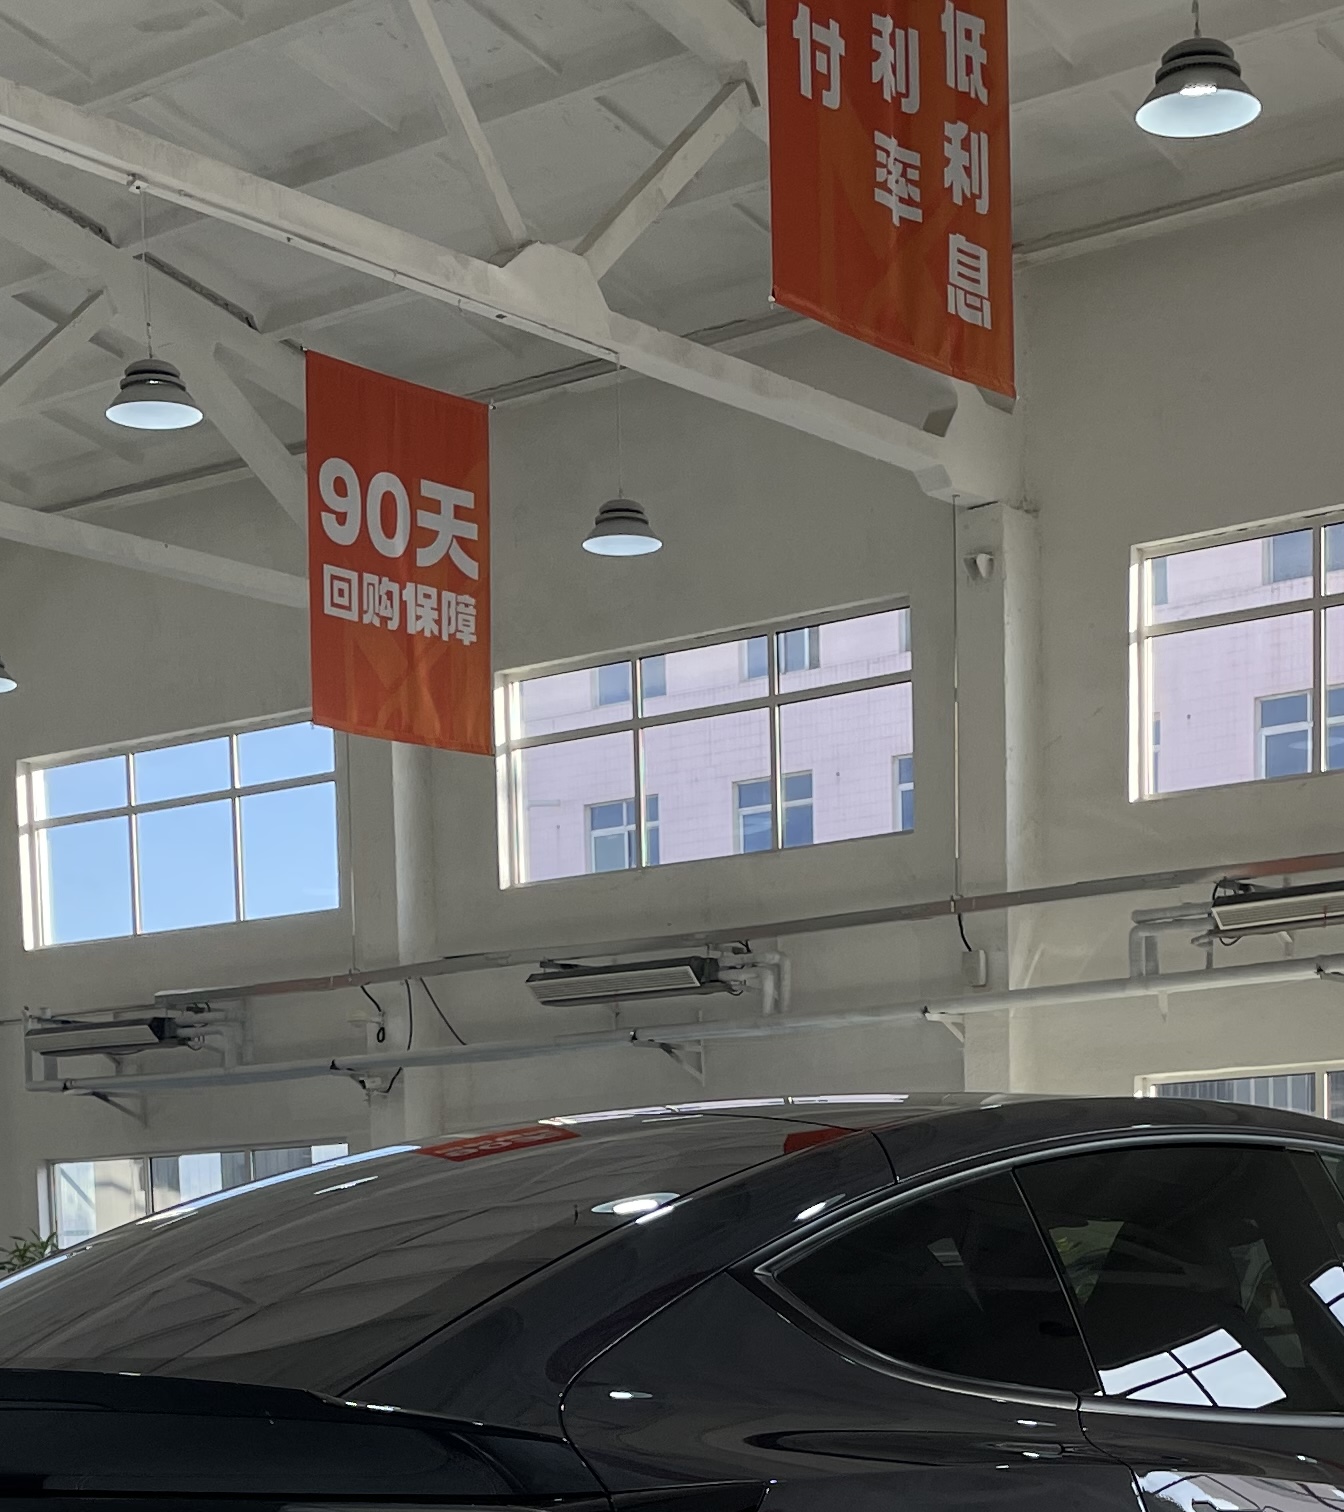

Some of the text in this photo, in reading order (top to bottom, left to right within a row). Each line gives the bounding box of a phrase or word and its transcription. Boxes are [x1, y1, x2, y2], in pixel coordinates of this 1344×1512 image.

[871, 12, 923, 227] 利率
[940, 0, 992, 330] 低利息
[318, 457, 480, 581] 90天
[322, 563, 478, 646] 回购保障
